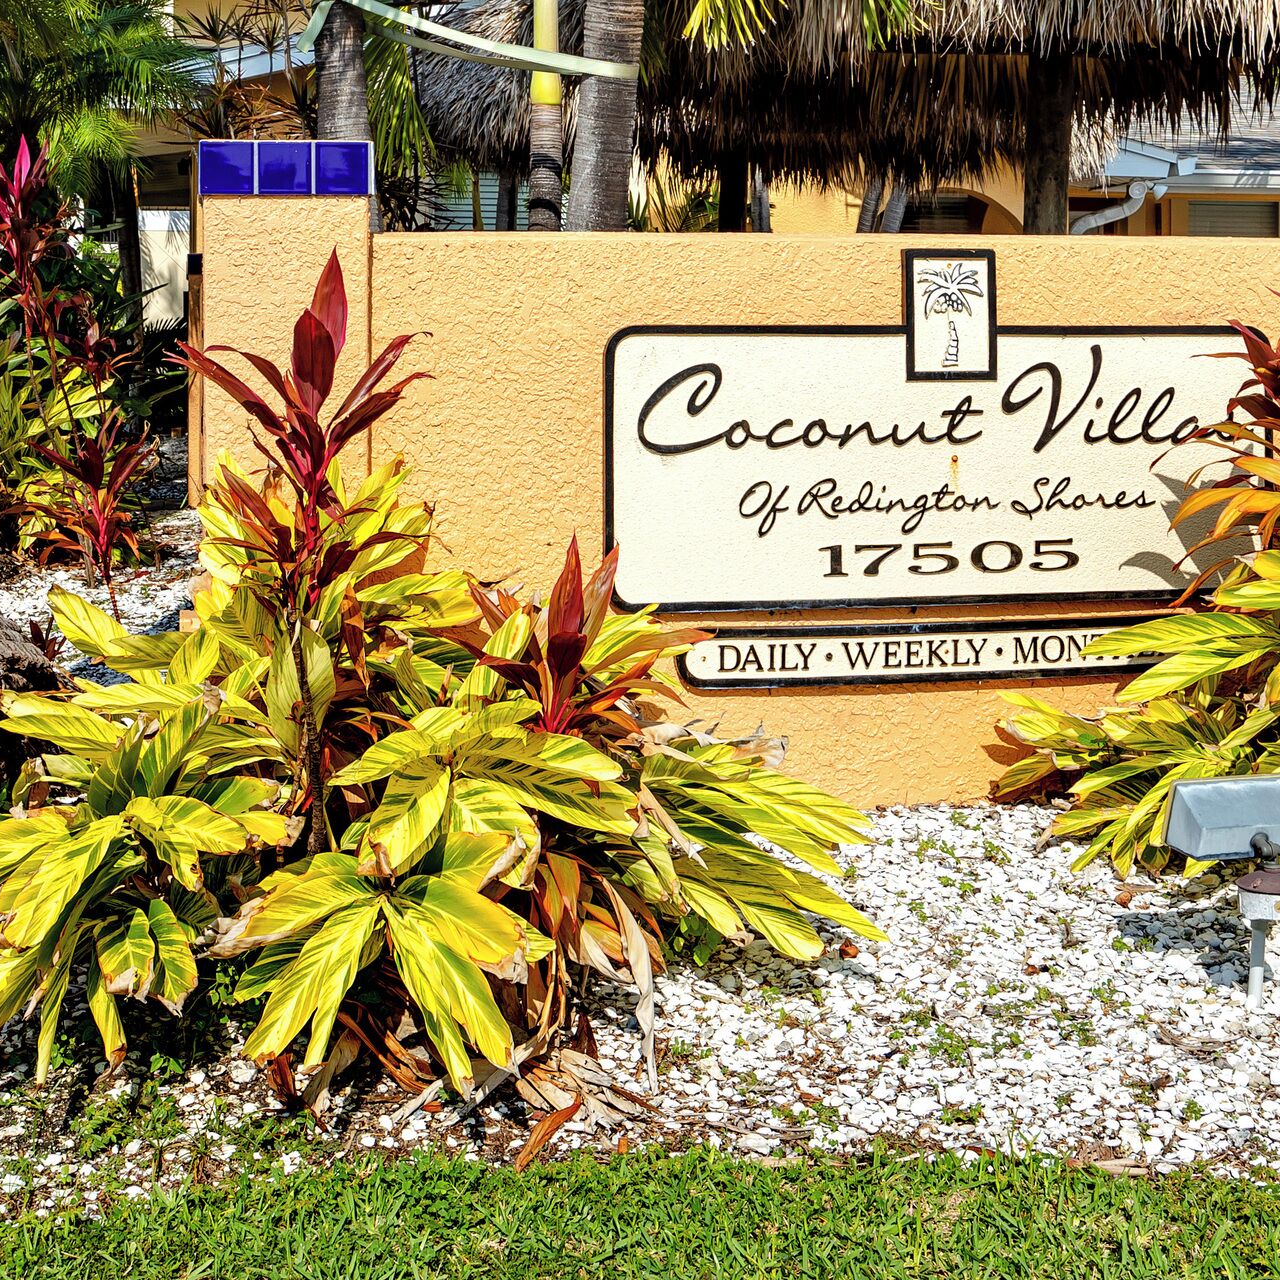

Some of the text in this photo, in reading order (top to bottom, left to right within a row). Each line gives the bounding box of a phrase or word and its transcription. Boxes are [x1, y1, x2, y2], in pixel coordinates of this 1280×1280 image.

[637, 363, 983, 456] Coconut
[738, 477, 1156, 538] Of Redington Shores
[818, 538, 1080, 578] 17505
[718, 642, 818, 673] DAILY
[842, 638, 988, 670] WEEKLY
